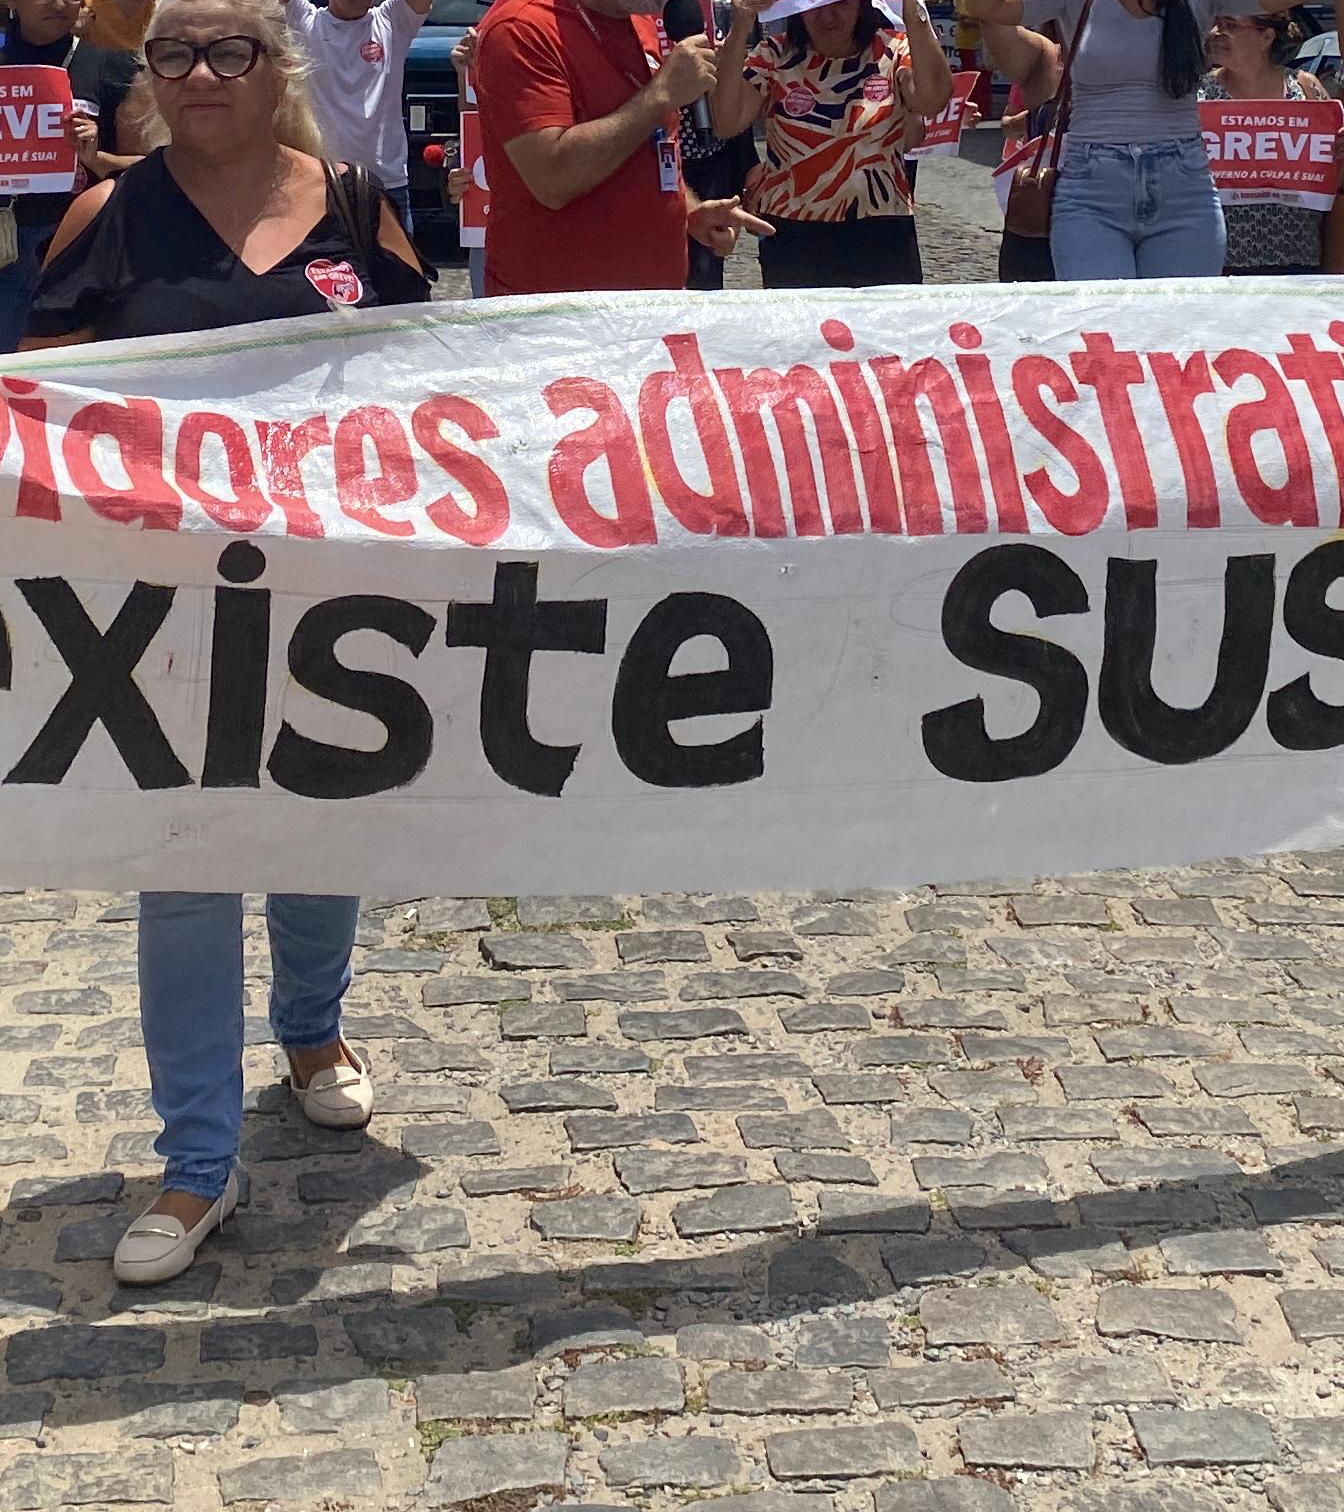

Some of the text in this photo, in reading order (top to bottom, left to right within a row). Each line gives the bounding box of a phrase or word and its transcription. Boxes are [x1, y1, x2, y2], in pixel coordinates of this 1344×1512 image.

[11, 85, 33, 98] EM
[1220, 115, 1309, 128] ESTAMOS EM
[1250, 171, 1258, 179] A
[1260, 170, 1291, 180] CULPA
